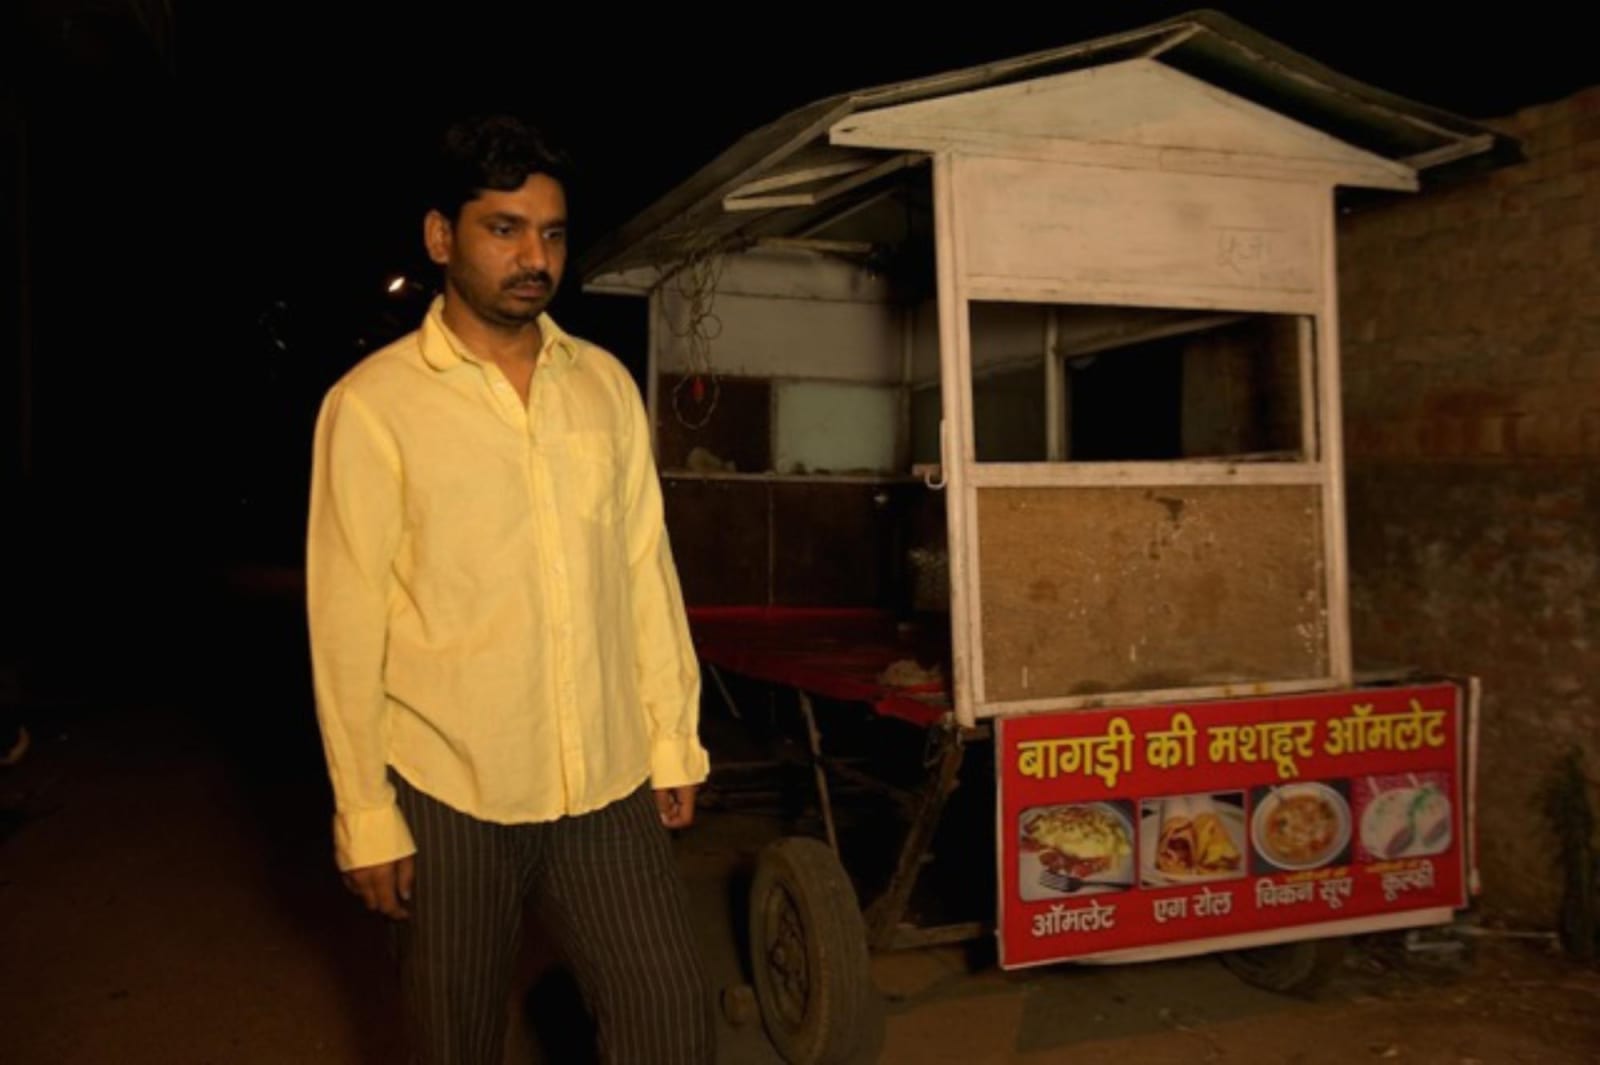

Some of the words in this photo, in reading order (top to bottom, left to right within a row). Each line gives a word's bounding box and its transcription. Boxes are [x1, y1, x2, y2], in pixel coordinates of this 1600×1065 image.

[1017, 716, 1135, 789] बागड़ी
[1145, 712, 1197, 769] की
[1207, 719, 1317, 780] मशहूर
[1323, 698, 1447, 756] ऑमलेट
[1152, 896, 1187, 923] एग
[1192, 886, 1233, 916] रोल
[1256, 877, 1314, 910] चिकन
[1319, 875, 1354, 910] सूप
[1030, 898, 1117, 938] ऑमलेट
